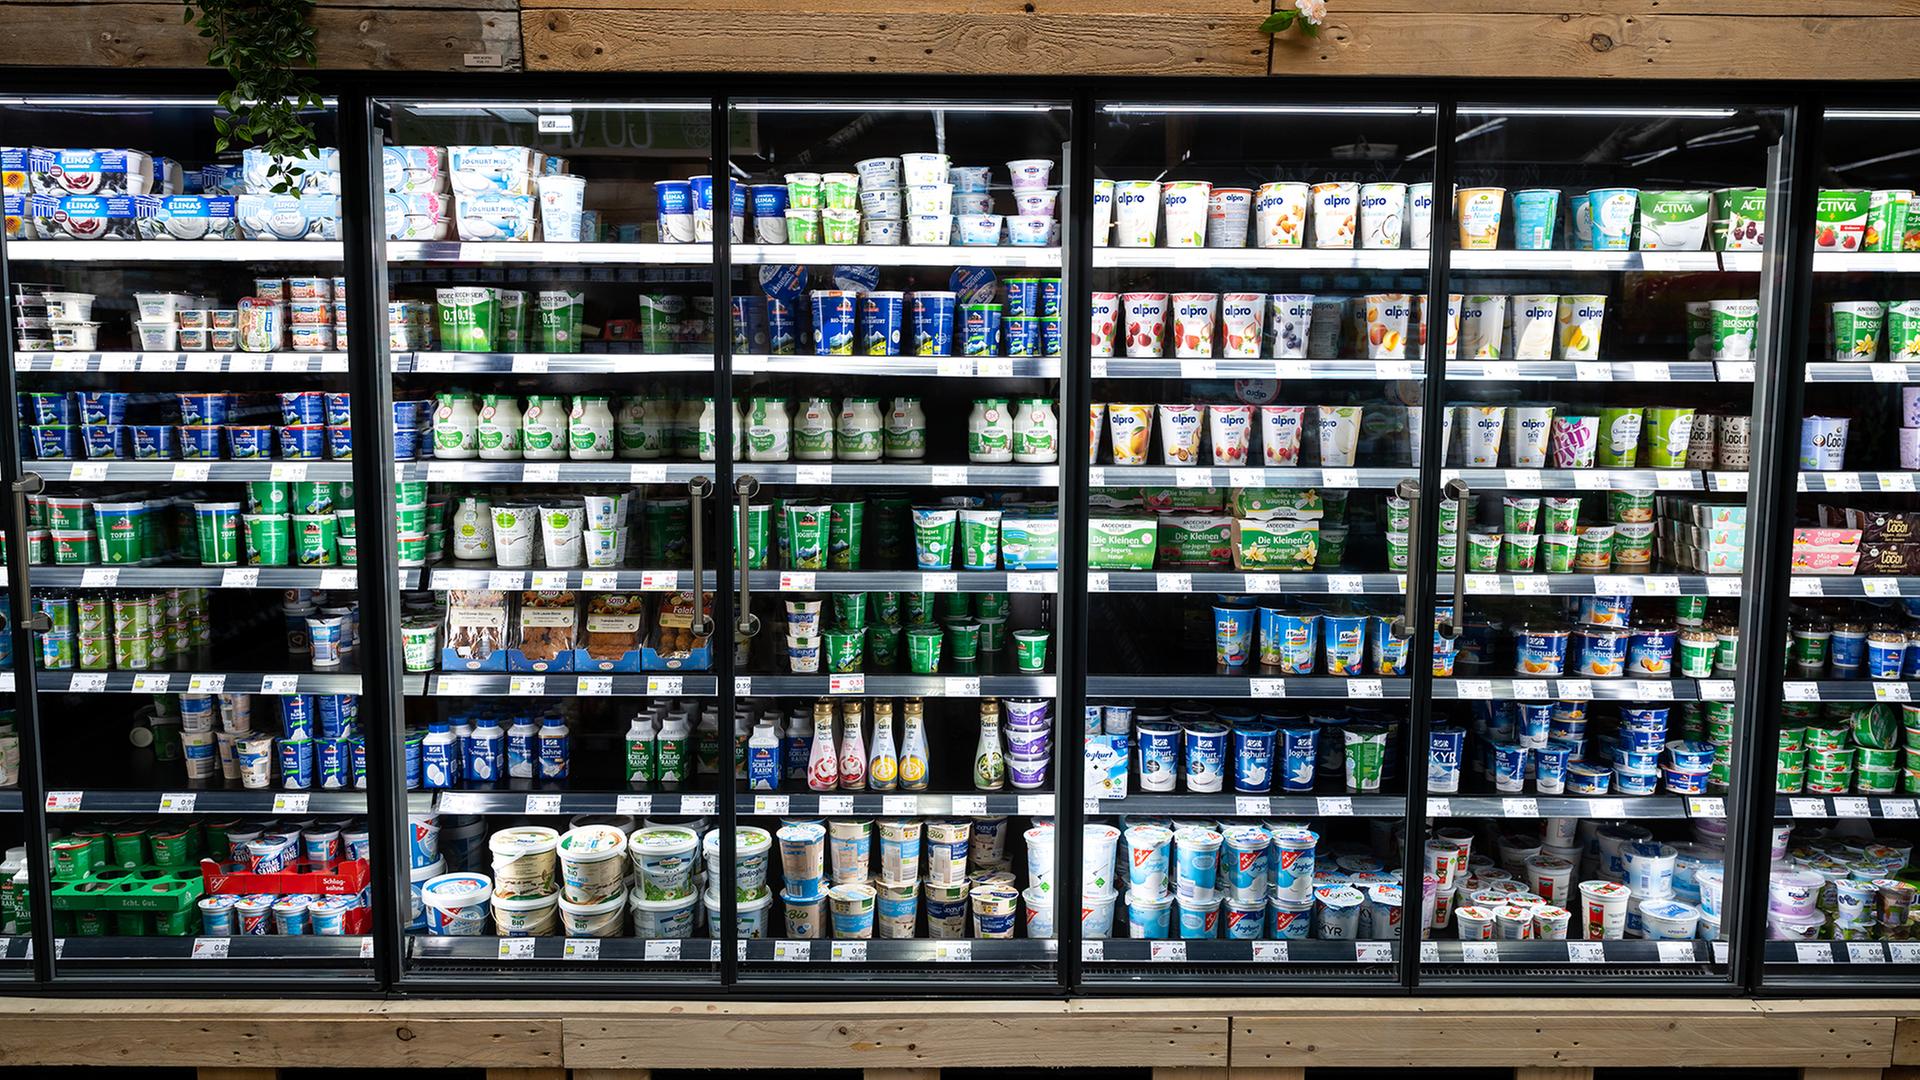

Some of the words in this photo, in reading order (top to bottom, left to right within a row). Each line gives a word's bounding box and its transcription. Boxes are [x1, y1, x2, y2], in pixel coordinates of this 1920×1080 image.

[61, 157, 93, 166] ELINAS
[1118, 192, 1144, 205] alpro
[1226, 194, 1244, 203] alpro
[1324, 194, 1350, 207] alpro
[1361, 194, 1386, 207] alpro
[66, 202, 100, 210] ELINAS
[168, 201, 202, 209] ELINAS
[1652, 203, 1694, 214] ACTIVIA
[1740, 200, 1765, 211] ACTI
[1132, 304, 1160, 317] alpro
[1180, 304, 1207, 317] alpro
[1225, 304, 1251, 317] alpro
[1526, 307, 1553, 320] alpro
[1111, 415, 1134, 426] alpro
[1172, 414, 1197, 425] alpro
[1220, 415, 1245, 427] alpro
[1271, 415, 1296, 427] alpro
[1477, 419, 1500, 430] alpro
[1521, 419, 1545, 430] alpro
[1886, 519, 1908, 532] Coco!
[1093, 536, 1107, 544] Die
[1108, 536, 1139, 544] Kleinen
[1175, 532, 1188, 540] Die
[1190, 532, 1218, 540] Kleinen
[1258, 536, 1271, 544] Die
[1273, 536, 1303, 544] Kleinen
[1881, 550, 1903, 564] Coco!
[541, 748, 562, 756] Sahne
[787, 910, 808, 920] Bio
